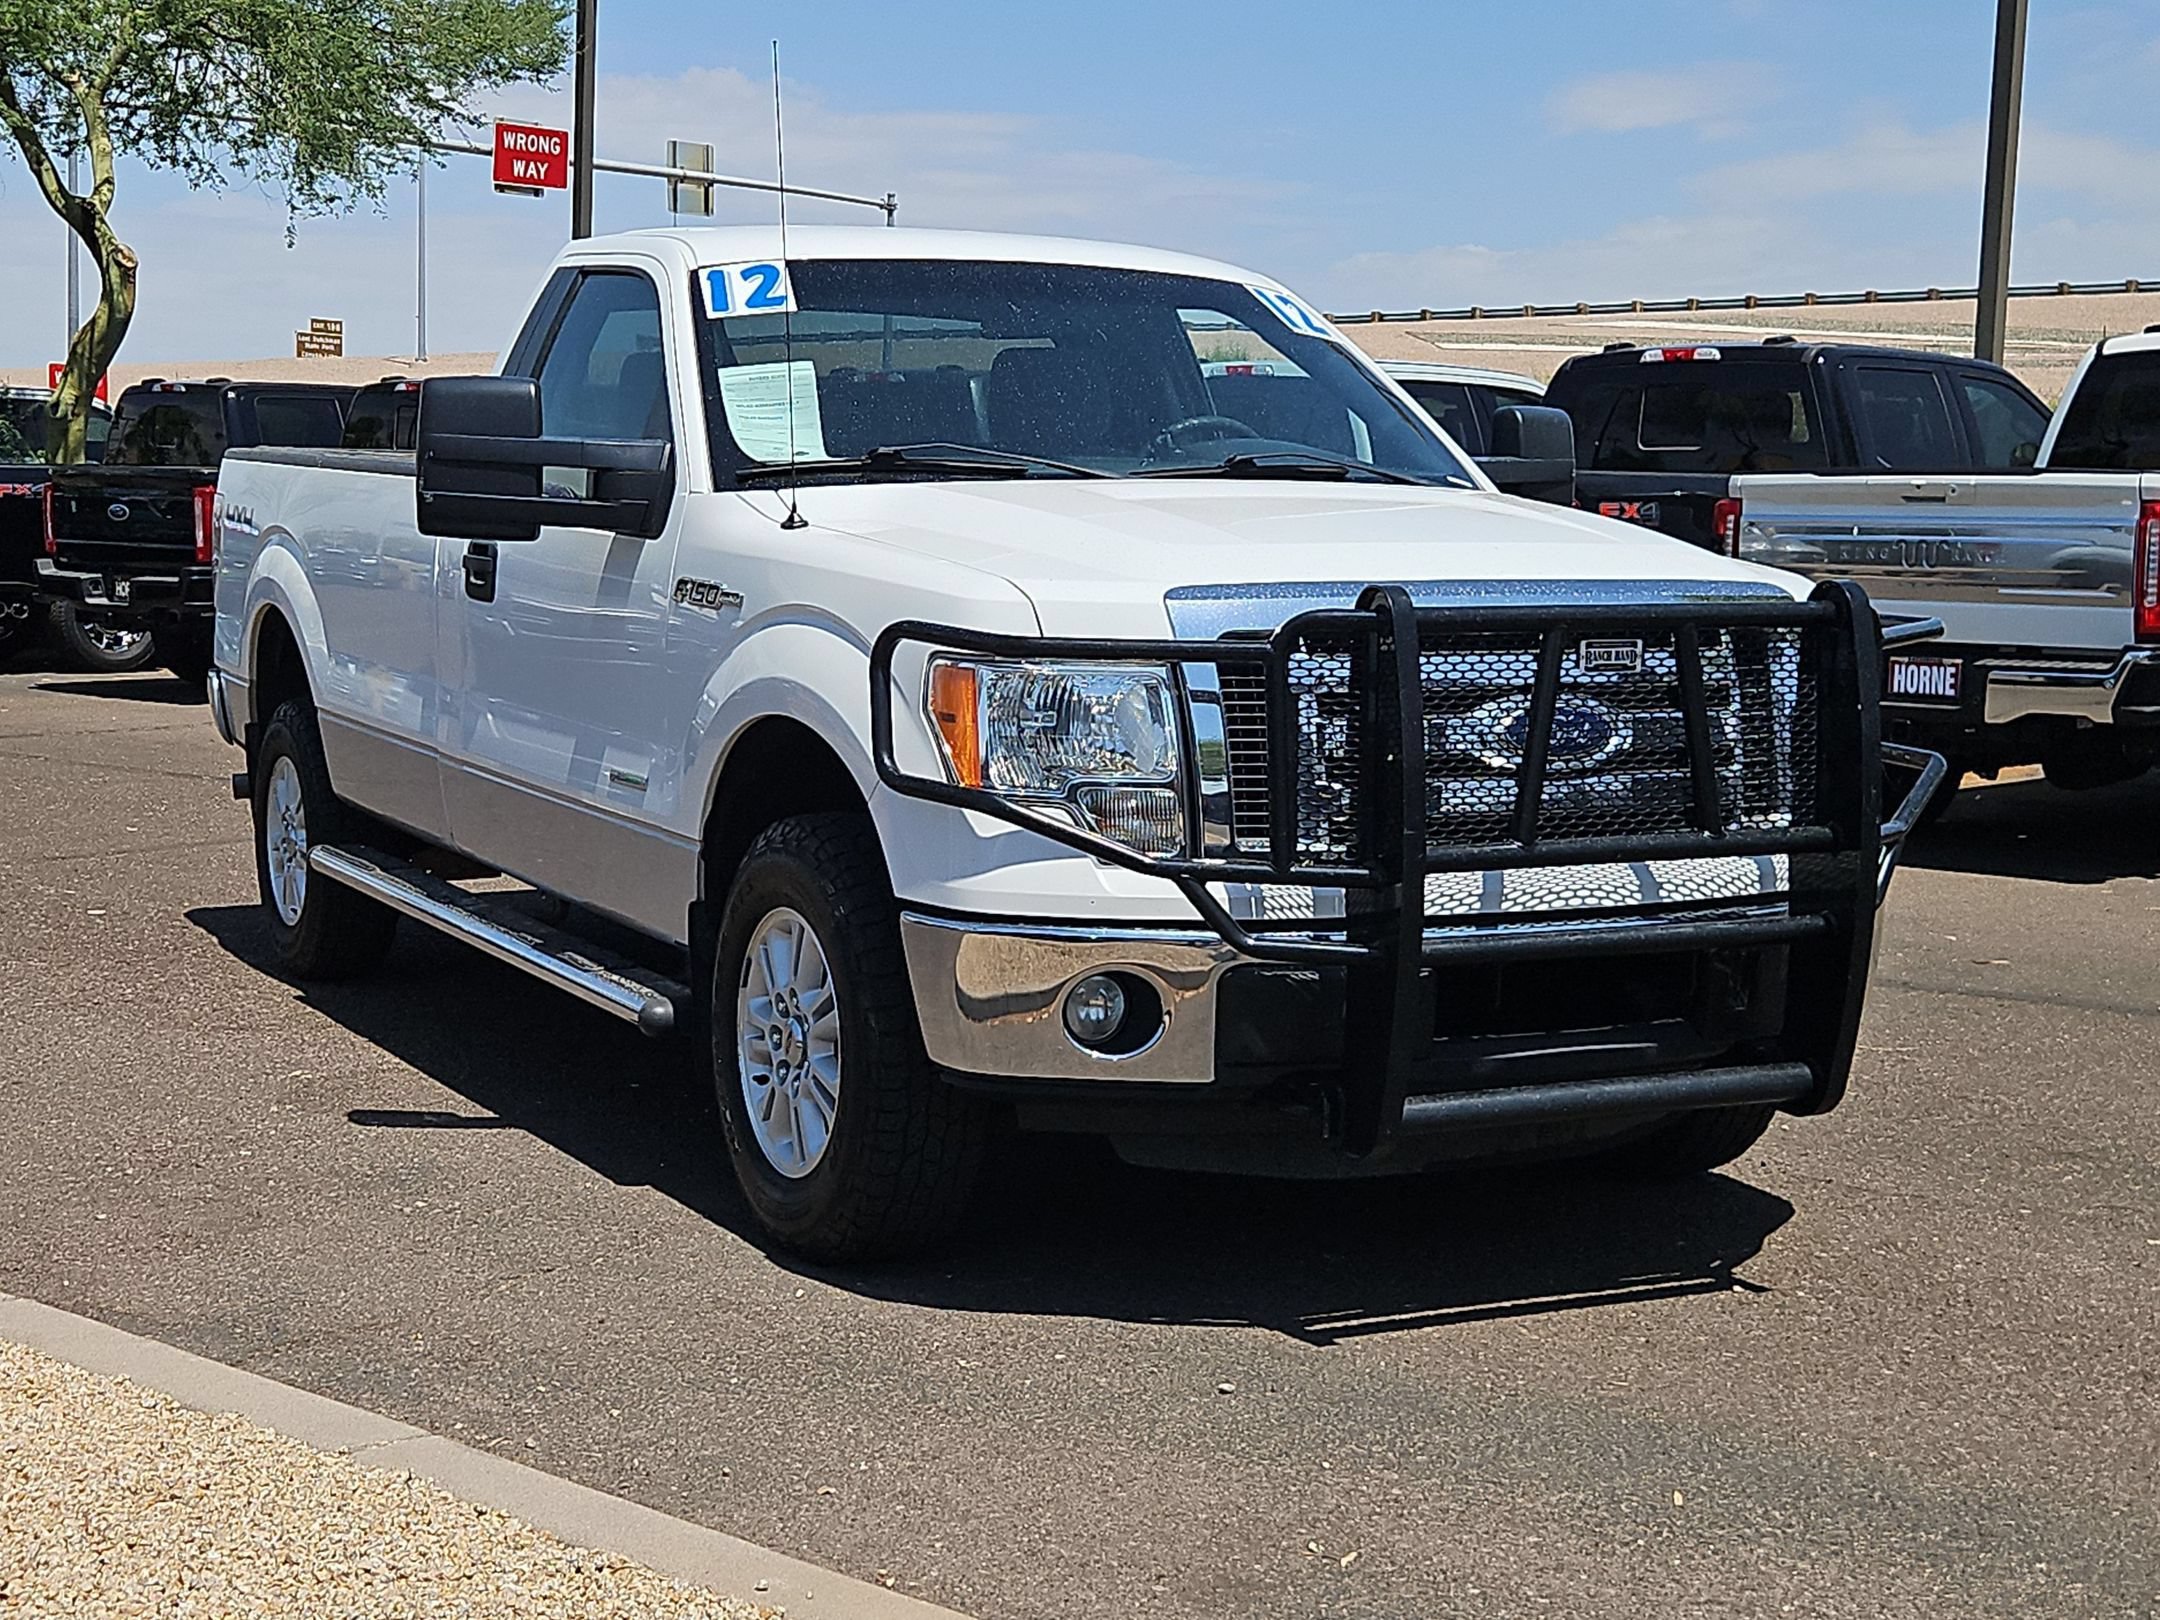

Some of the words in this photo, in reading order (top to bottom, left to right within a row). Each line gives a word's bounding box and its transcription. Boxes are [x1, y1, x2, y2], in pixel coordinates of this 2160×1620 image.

[503, 131, 561, 155] WRONG
[513, 159, 549, 180] WAY
[706, 264, 788, 312] 12
[1893, 663, 1956, 696] HORNE
